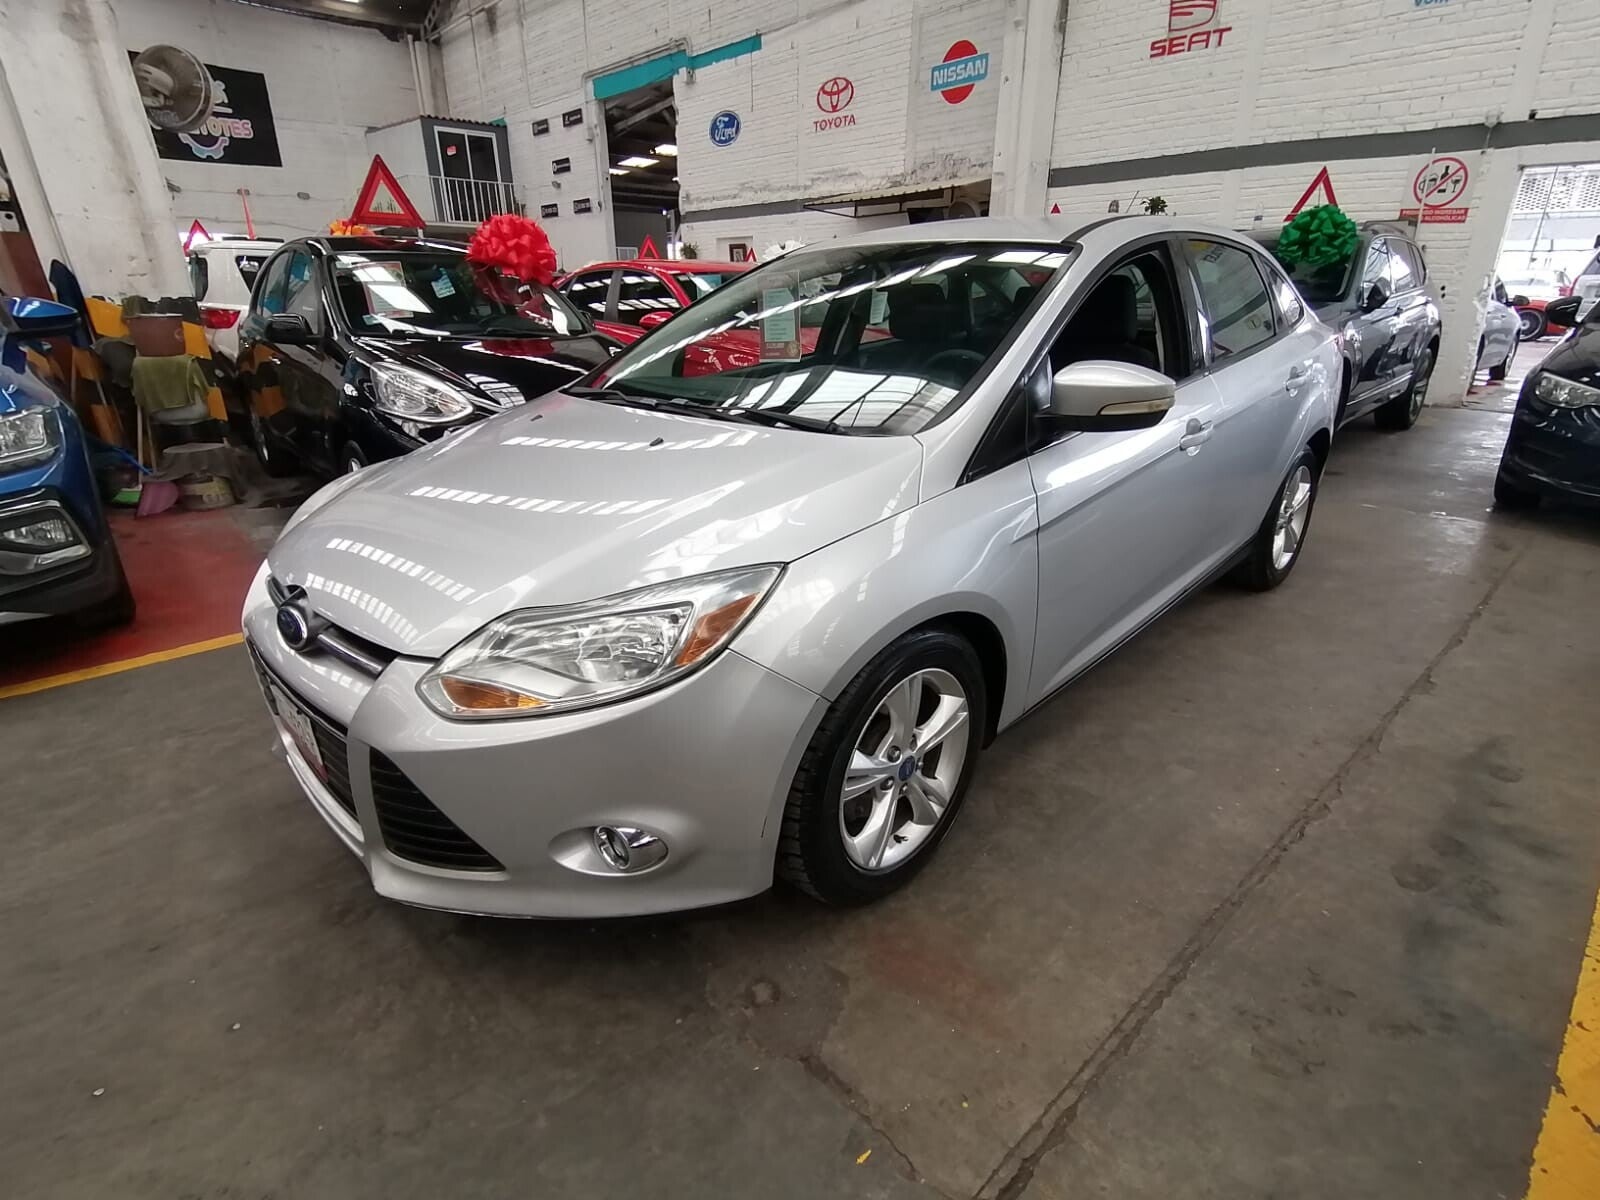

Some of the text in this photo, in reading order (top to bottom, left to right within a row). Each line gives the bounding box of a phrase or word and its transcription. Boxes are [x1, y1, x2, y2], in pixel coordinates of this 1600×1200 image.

[1150, 27, 1232, 58] SEAT
[933, 59, 986, 86] NISSAN
[715, 116, 738, 141] Ford
[813, 114, 856, 133] TOYOTA
